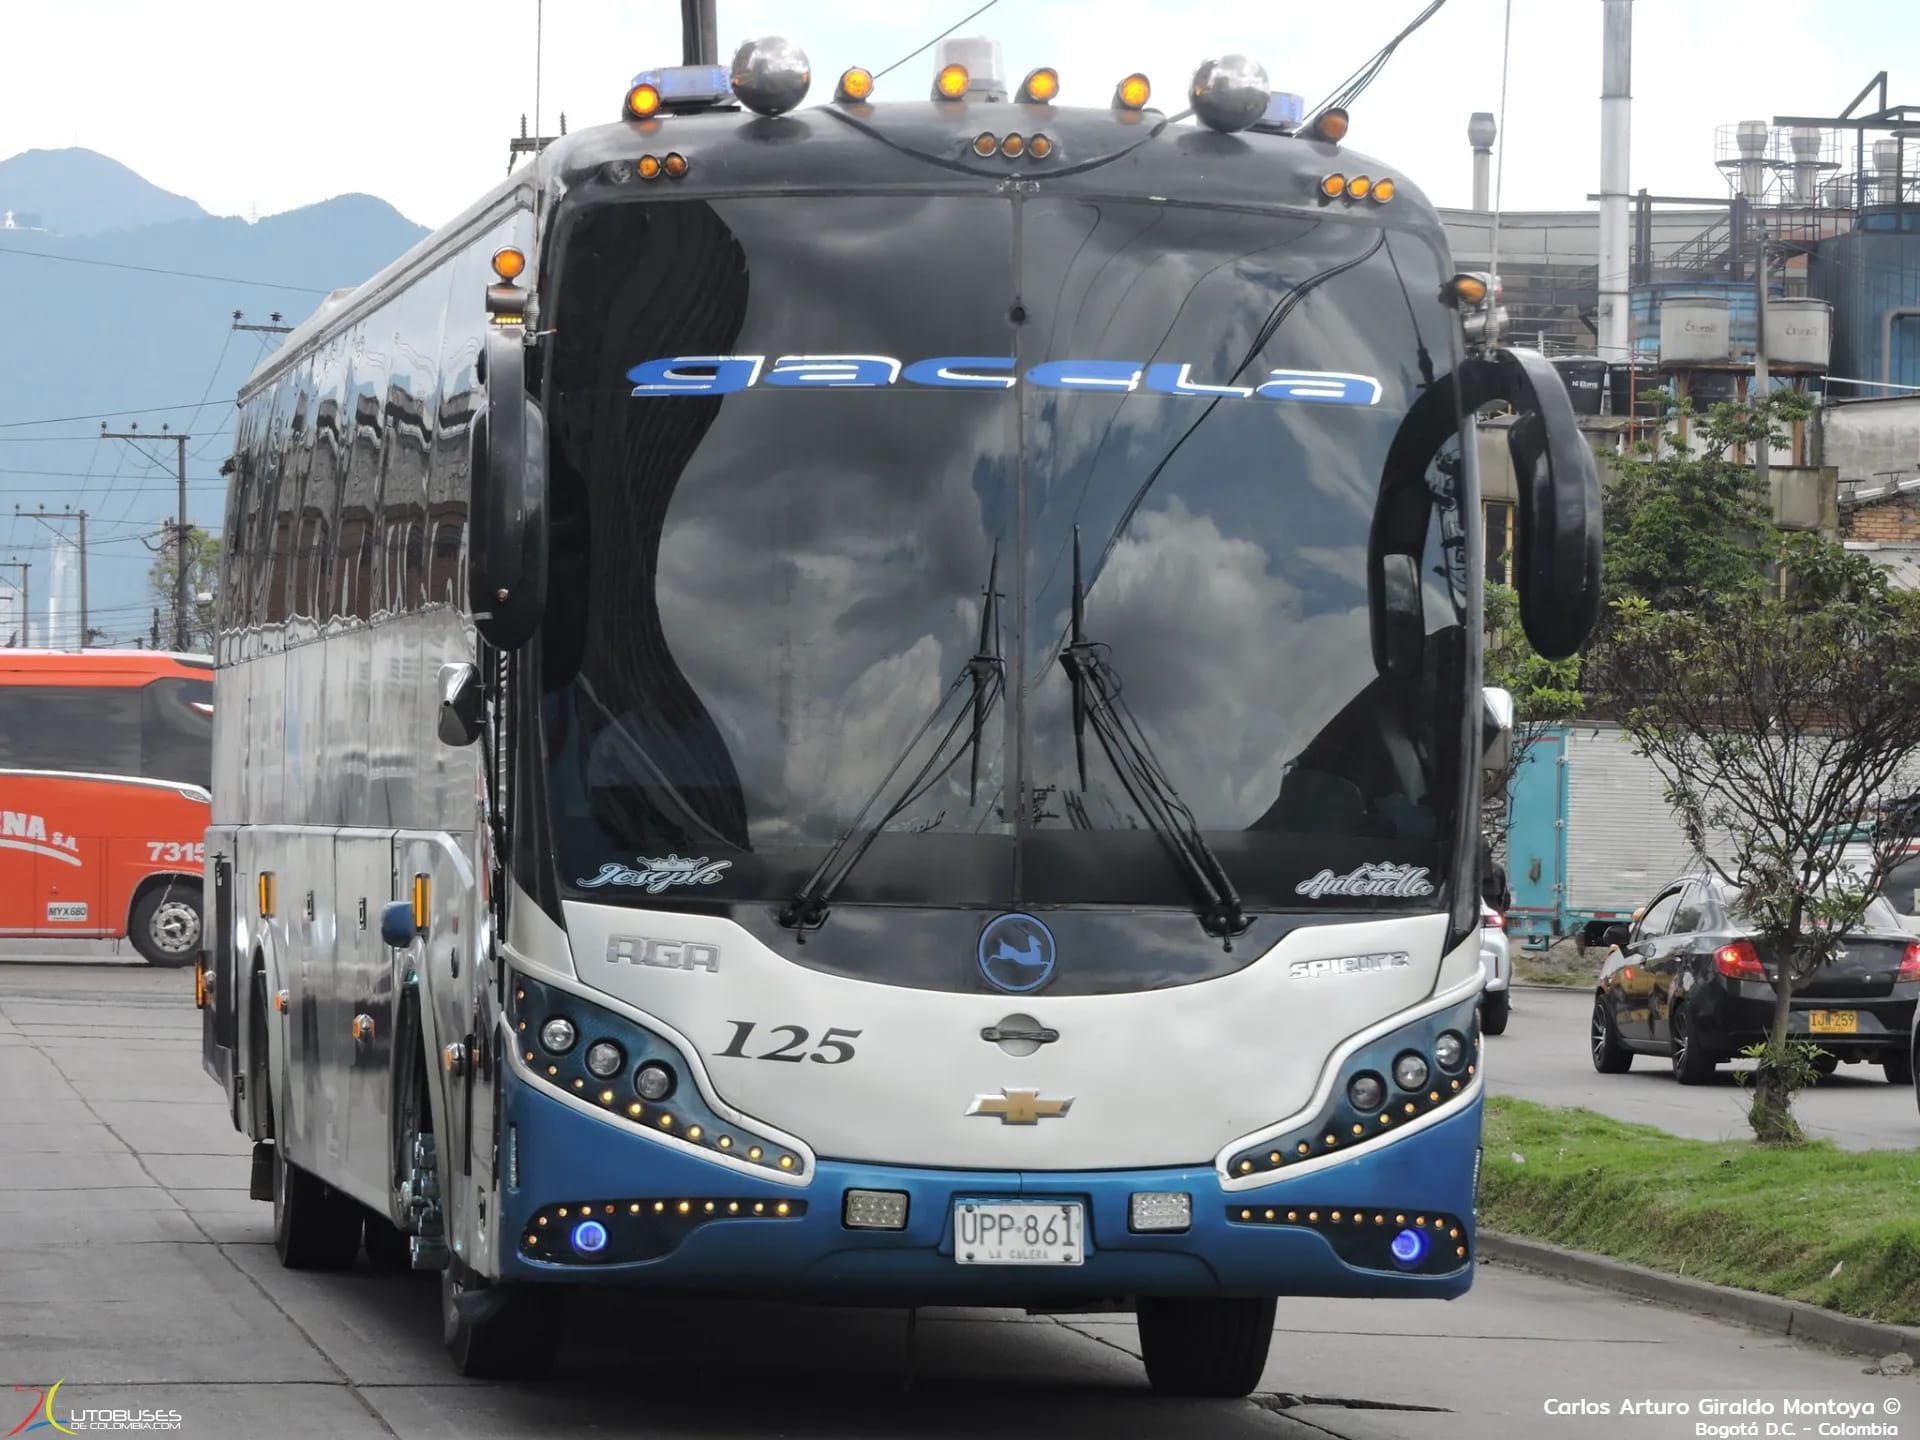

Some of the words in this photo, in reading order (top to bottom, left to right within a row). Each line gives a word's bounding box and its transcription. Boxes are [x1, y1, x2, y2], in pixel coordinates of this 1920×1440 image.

[0, 810, 47, 842] NA
[146, 841, 205, 862] 7315
[576, 860, 733, 894] Joseph
[606, 934, 721, 973] AGA
[711, 1020, 864, 1064] 125
